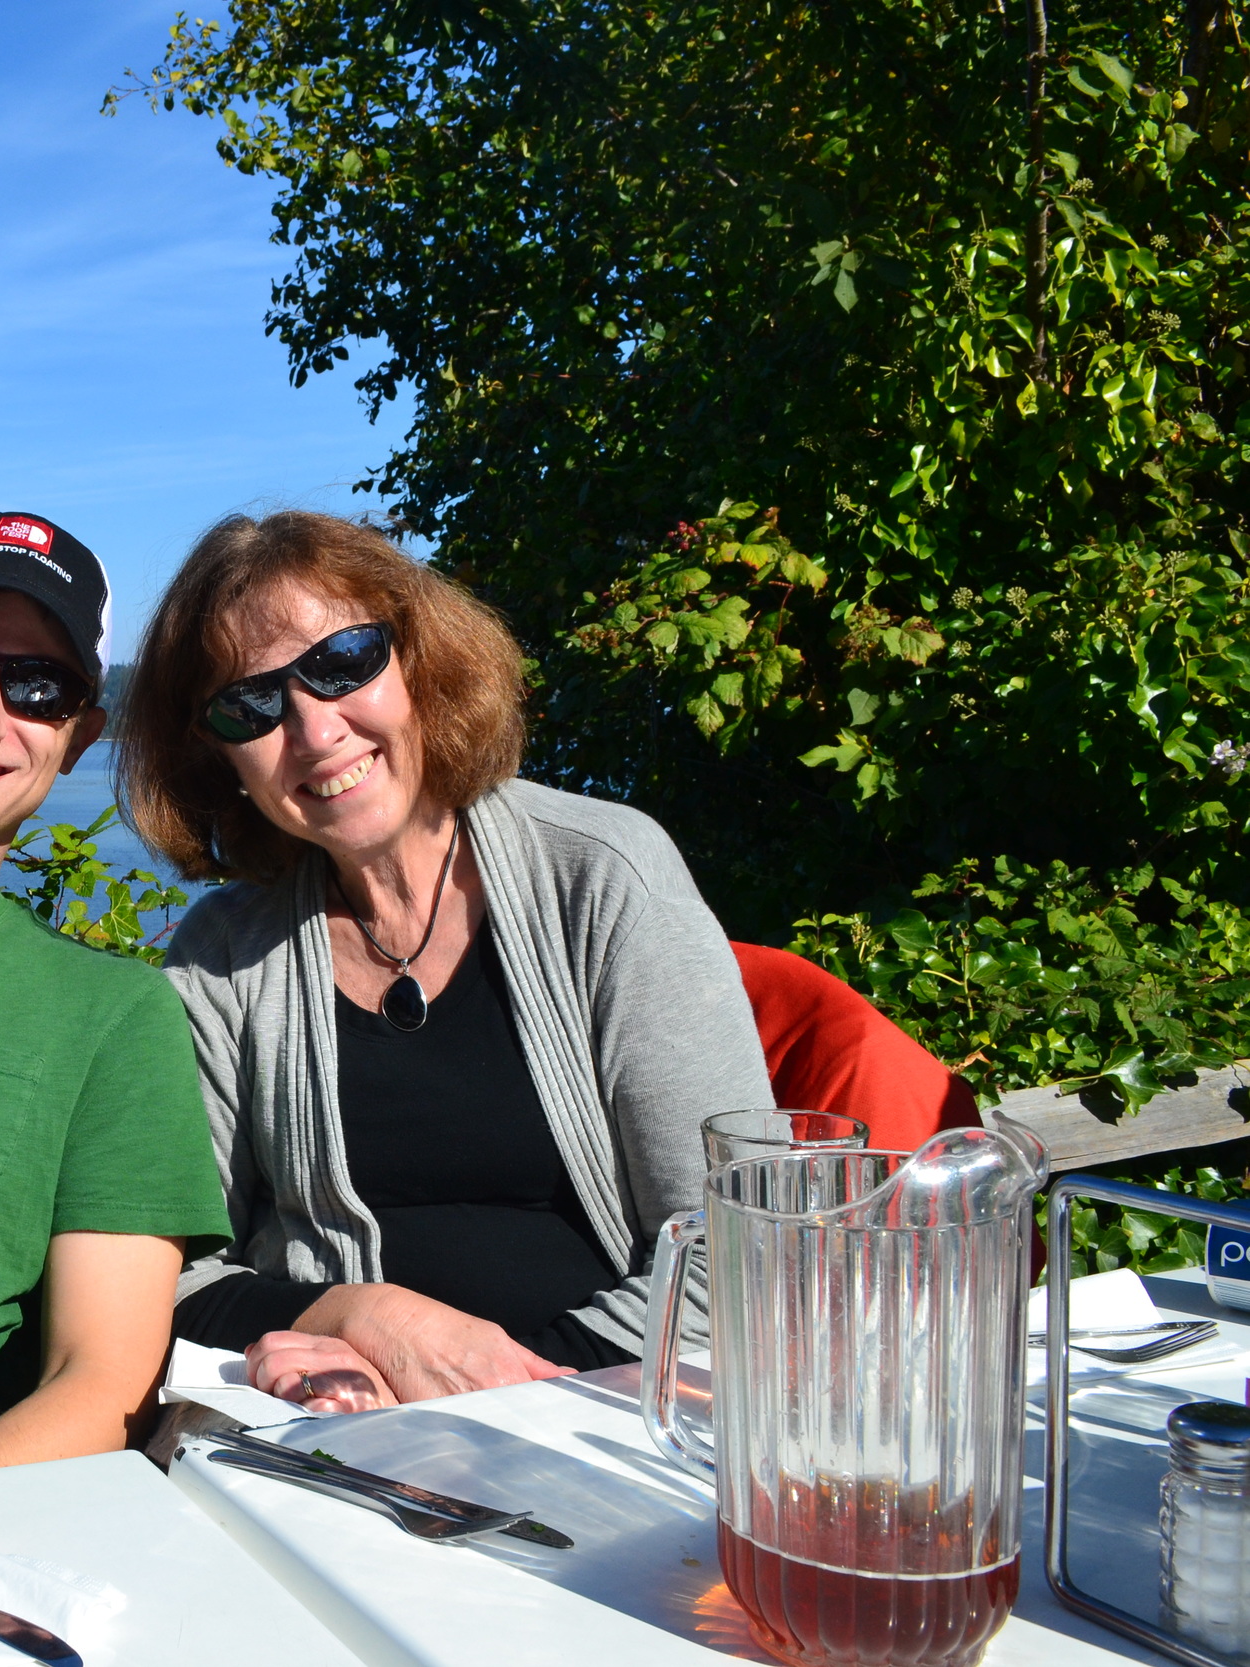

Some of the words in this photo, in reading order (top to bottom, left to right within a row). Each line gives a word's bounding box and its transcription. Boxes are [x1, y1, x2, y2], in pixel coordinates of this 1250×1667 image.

[11, 522, 30, 530] THE
[2, 531, 28, 540] FEST
[28, 551, 72, 583] FLOATING
